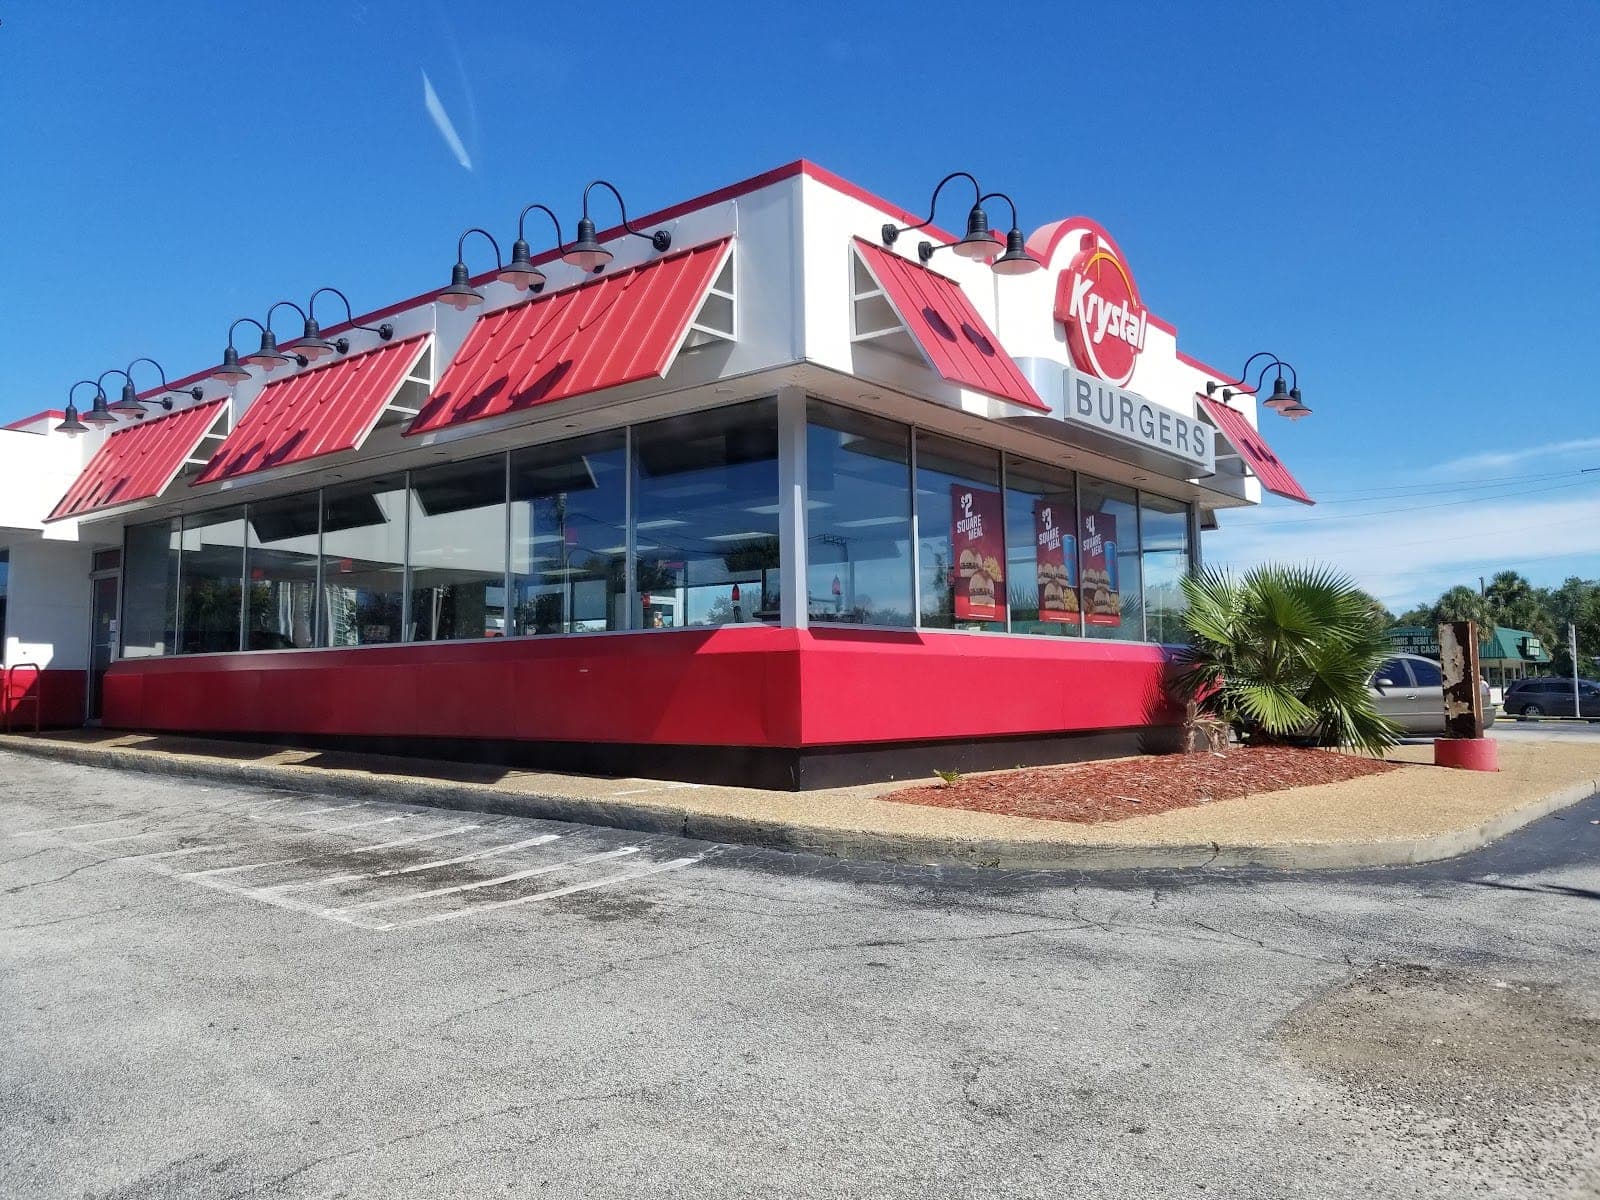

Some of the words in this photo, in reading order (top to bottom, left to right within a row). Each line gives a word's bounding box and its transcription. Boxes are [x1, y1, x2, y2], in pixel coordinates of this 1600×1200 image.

[1069, 273, 1147, 350] Krystal
[1076, 379, 1206, 457] BURGERS
[960, 493, 973, 518] $2
[957, 514, 982, 533] SQUARE
[1041, 507, 1052, 530] $3
[1085, 515, 1096, 537] $4
[968, 527, 983, 540] MEAL
[1039, 526, 1059, 545] SQUARE
[1083, 533, 1102, 551] SQUARE
[1048, 538, 1061, 551] MEAL
[1091, 544, 1103, 557] MEAL
